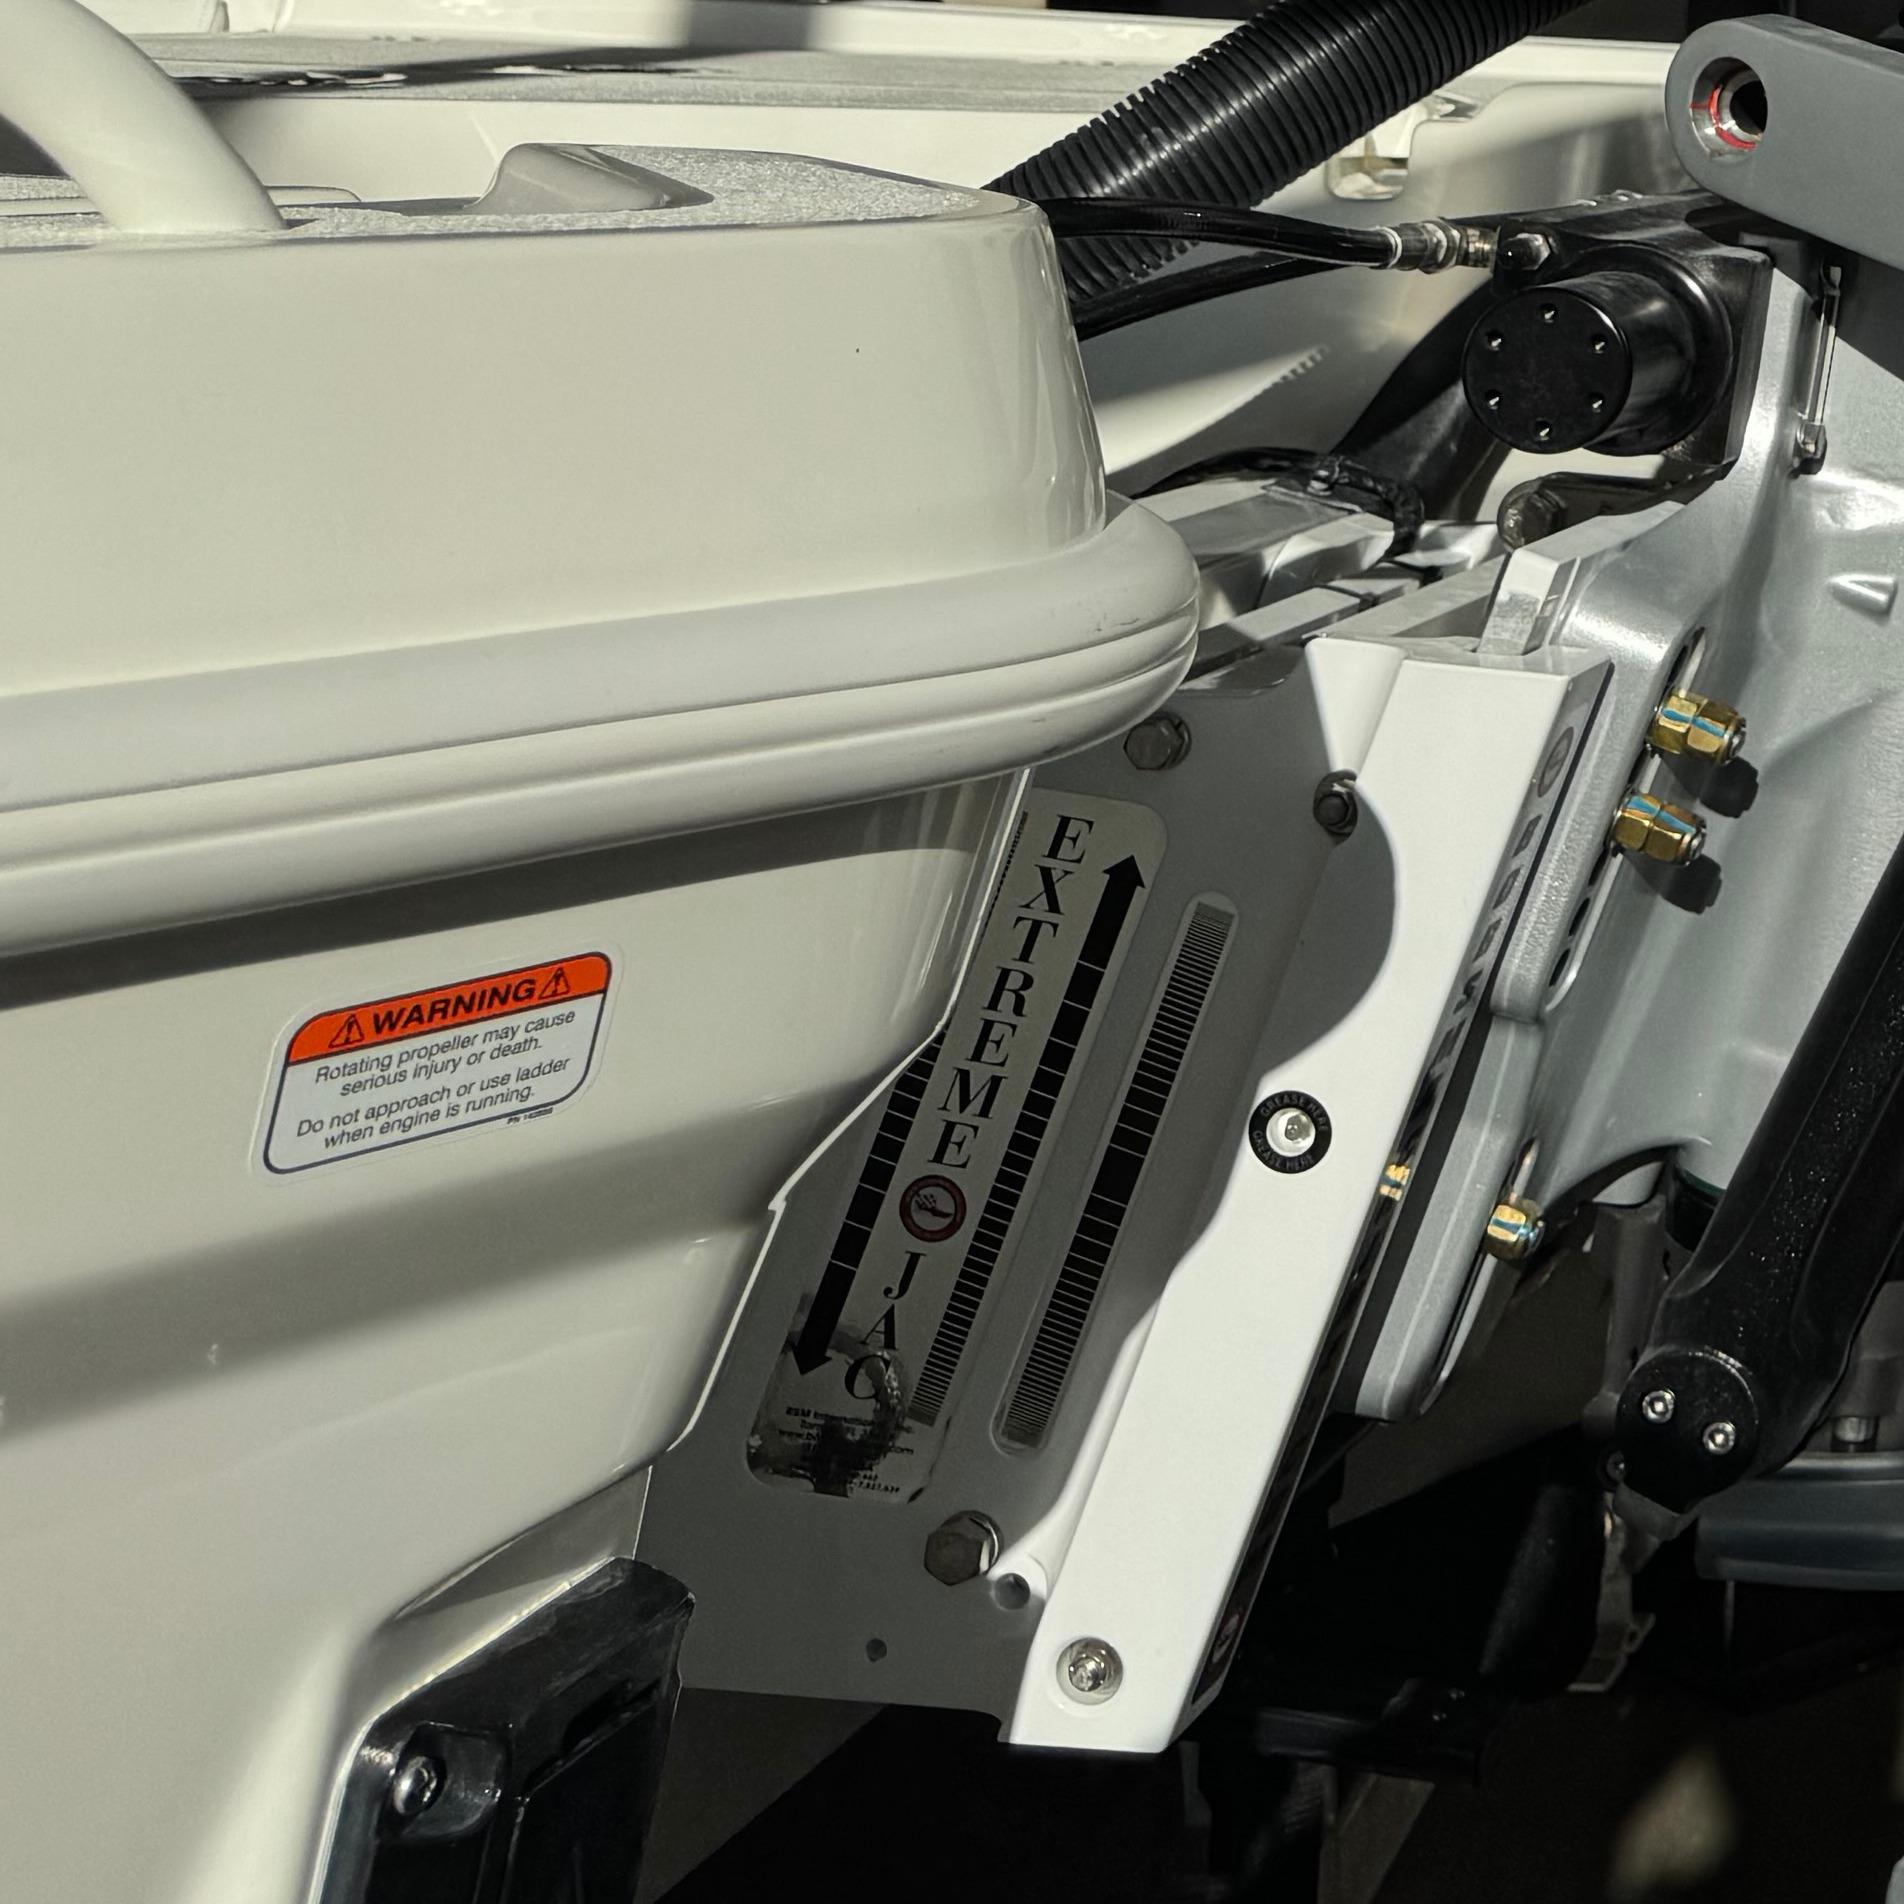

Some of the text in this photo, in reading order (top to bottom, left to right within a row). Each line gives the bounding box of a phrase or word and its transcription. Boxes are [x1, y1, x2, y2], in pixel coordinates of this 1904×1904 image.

[373, 978, 536, 1035] WARNING
[928, 814, 1095, 1170] EXTREME
[315, 1010, 576, 1084] Rotating propeller may cause
[340, 1035, 543, 1097] serious injury or death.
[296, 1056, 571, 1137] Do not approach or use ladder
[324, 1084, 535, 1149] when engine is running.
[1260, 1093, 1306, 1117] GREASE
[1252, 1130, 1285, 1169] GREASE
